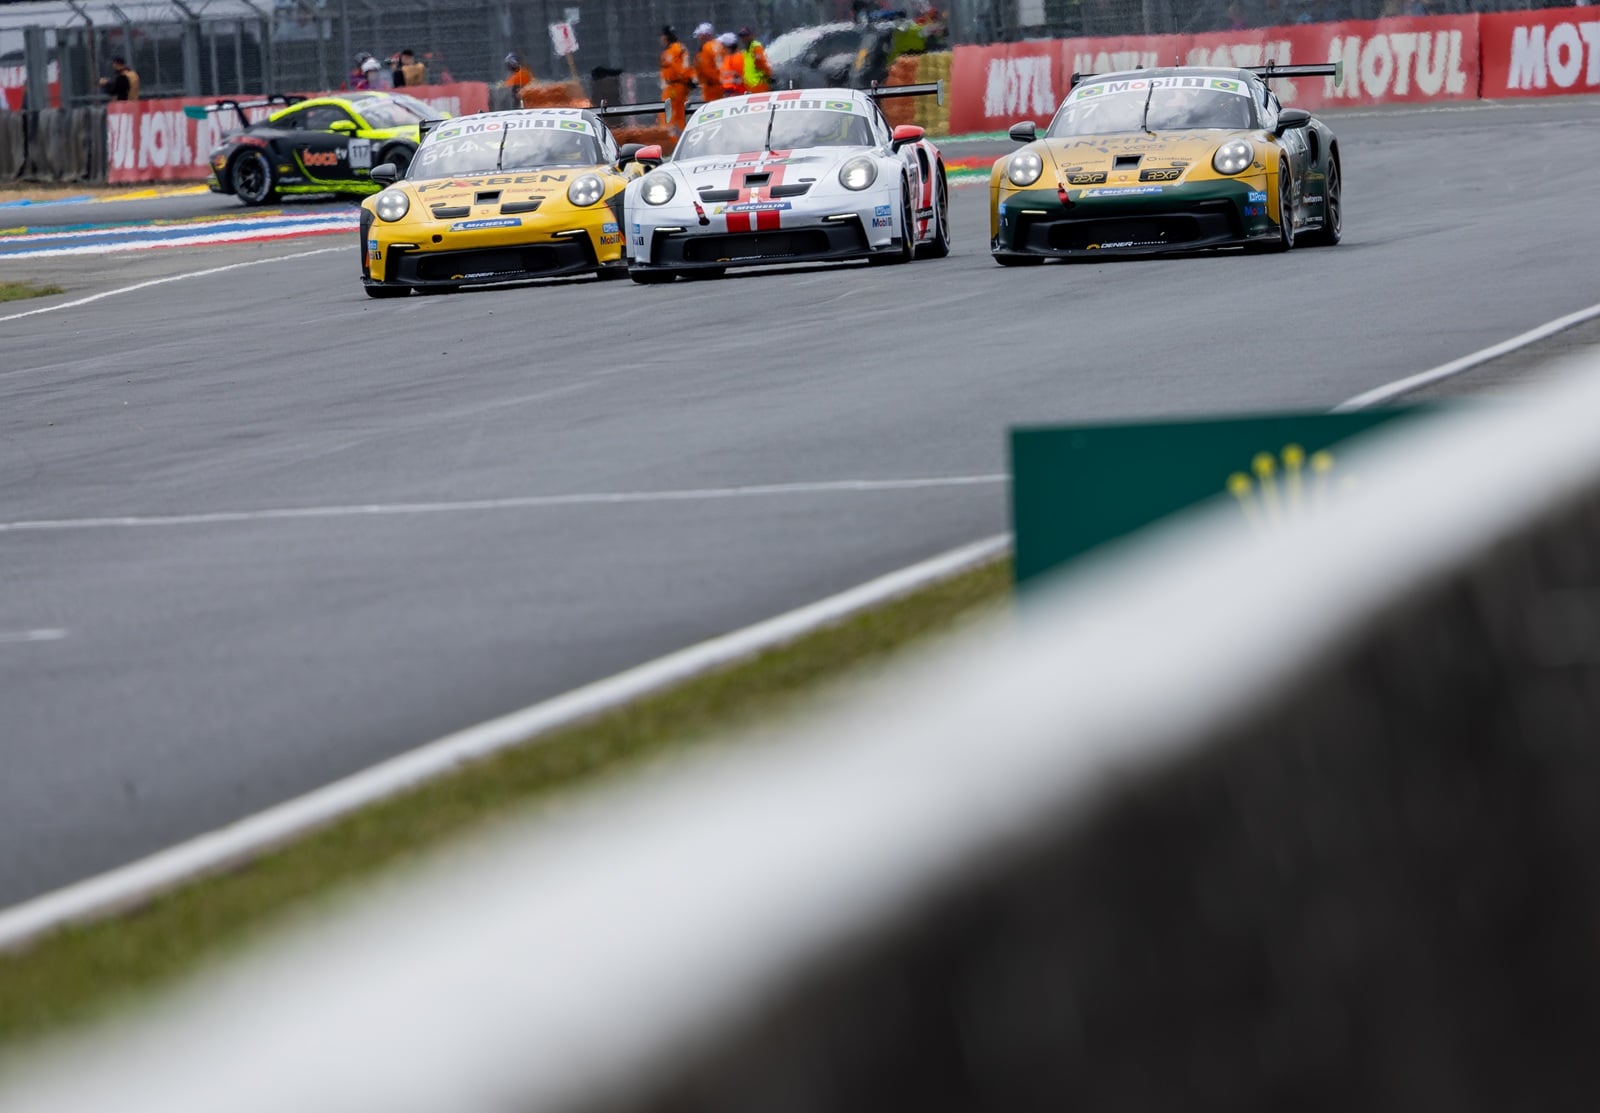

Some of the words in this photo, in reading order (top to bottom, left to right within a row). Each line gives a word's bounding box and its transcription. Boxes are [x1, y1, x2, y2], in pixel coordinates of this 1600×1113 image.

[1324, 30, 1467, 98] MOTUL
[984, 55, 1055, 118] MOTUL
[1108, 78, 1177, 93] Mobil
[729, 101, 796, 116] Mobil
[1064, 103, 1099, 123] 17
[465, 119, 531, 134] Mobil
[688, 123, 722, 146] 97
[418, 174, 568, 193] FARBEN
[1101, 187, 1155, 195] MICHELIN
[736, 203, 785, 211] MICHELIN
[465, 219, 516, 229] MICHELIN
